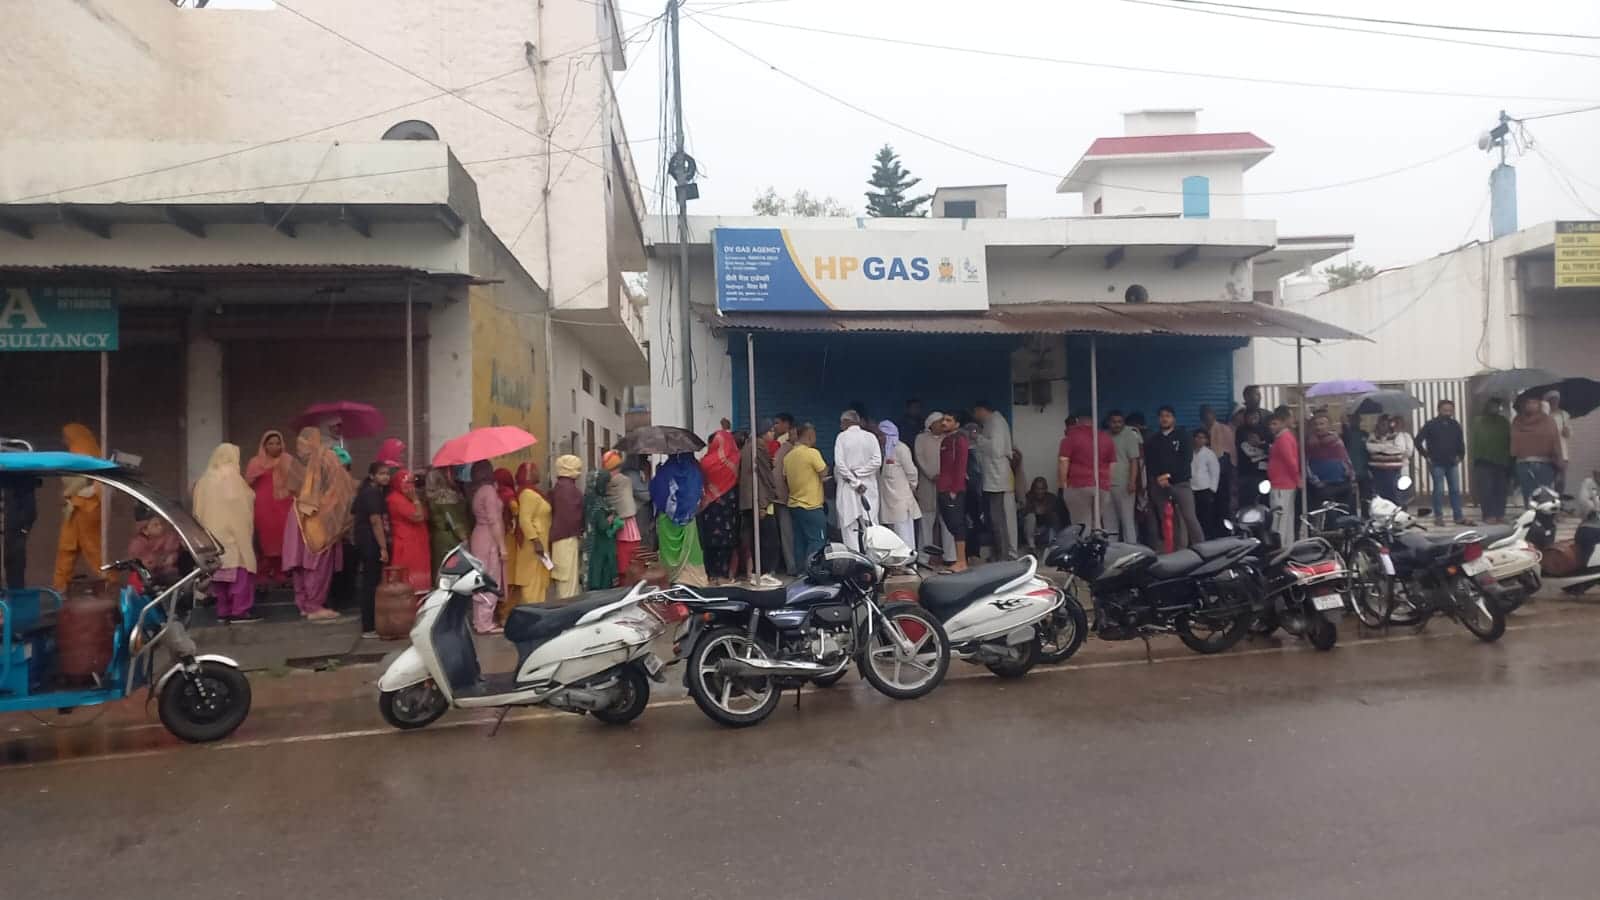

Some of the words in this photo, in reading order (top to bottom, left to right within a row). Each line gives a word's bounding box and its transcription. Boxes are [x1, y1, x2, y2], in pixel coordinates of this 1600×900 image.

[735, 246, 750, 254] GAS
[751, 246, 780, 254] AGENCY
[814, 256, 858, 280] HP
[862, 256, 930, 281] GAS
[0, 288, 47, 328] A
